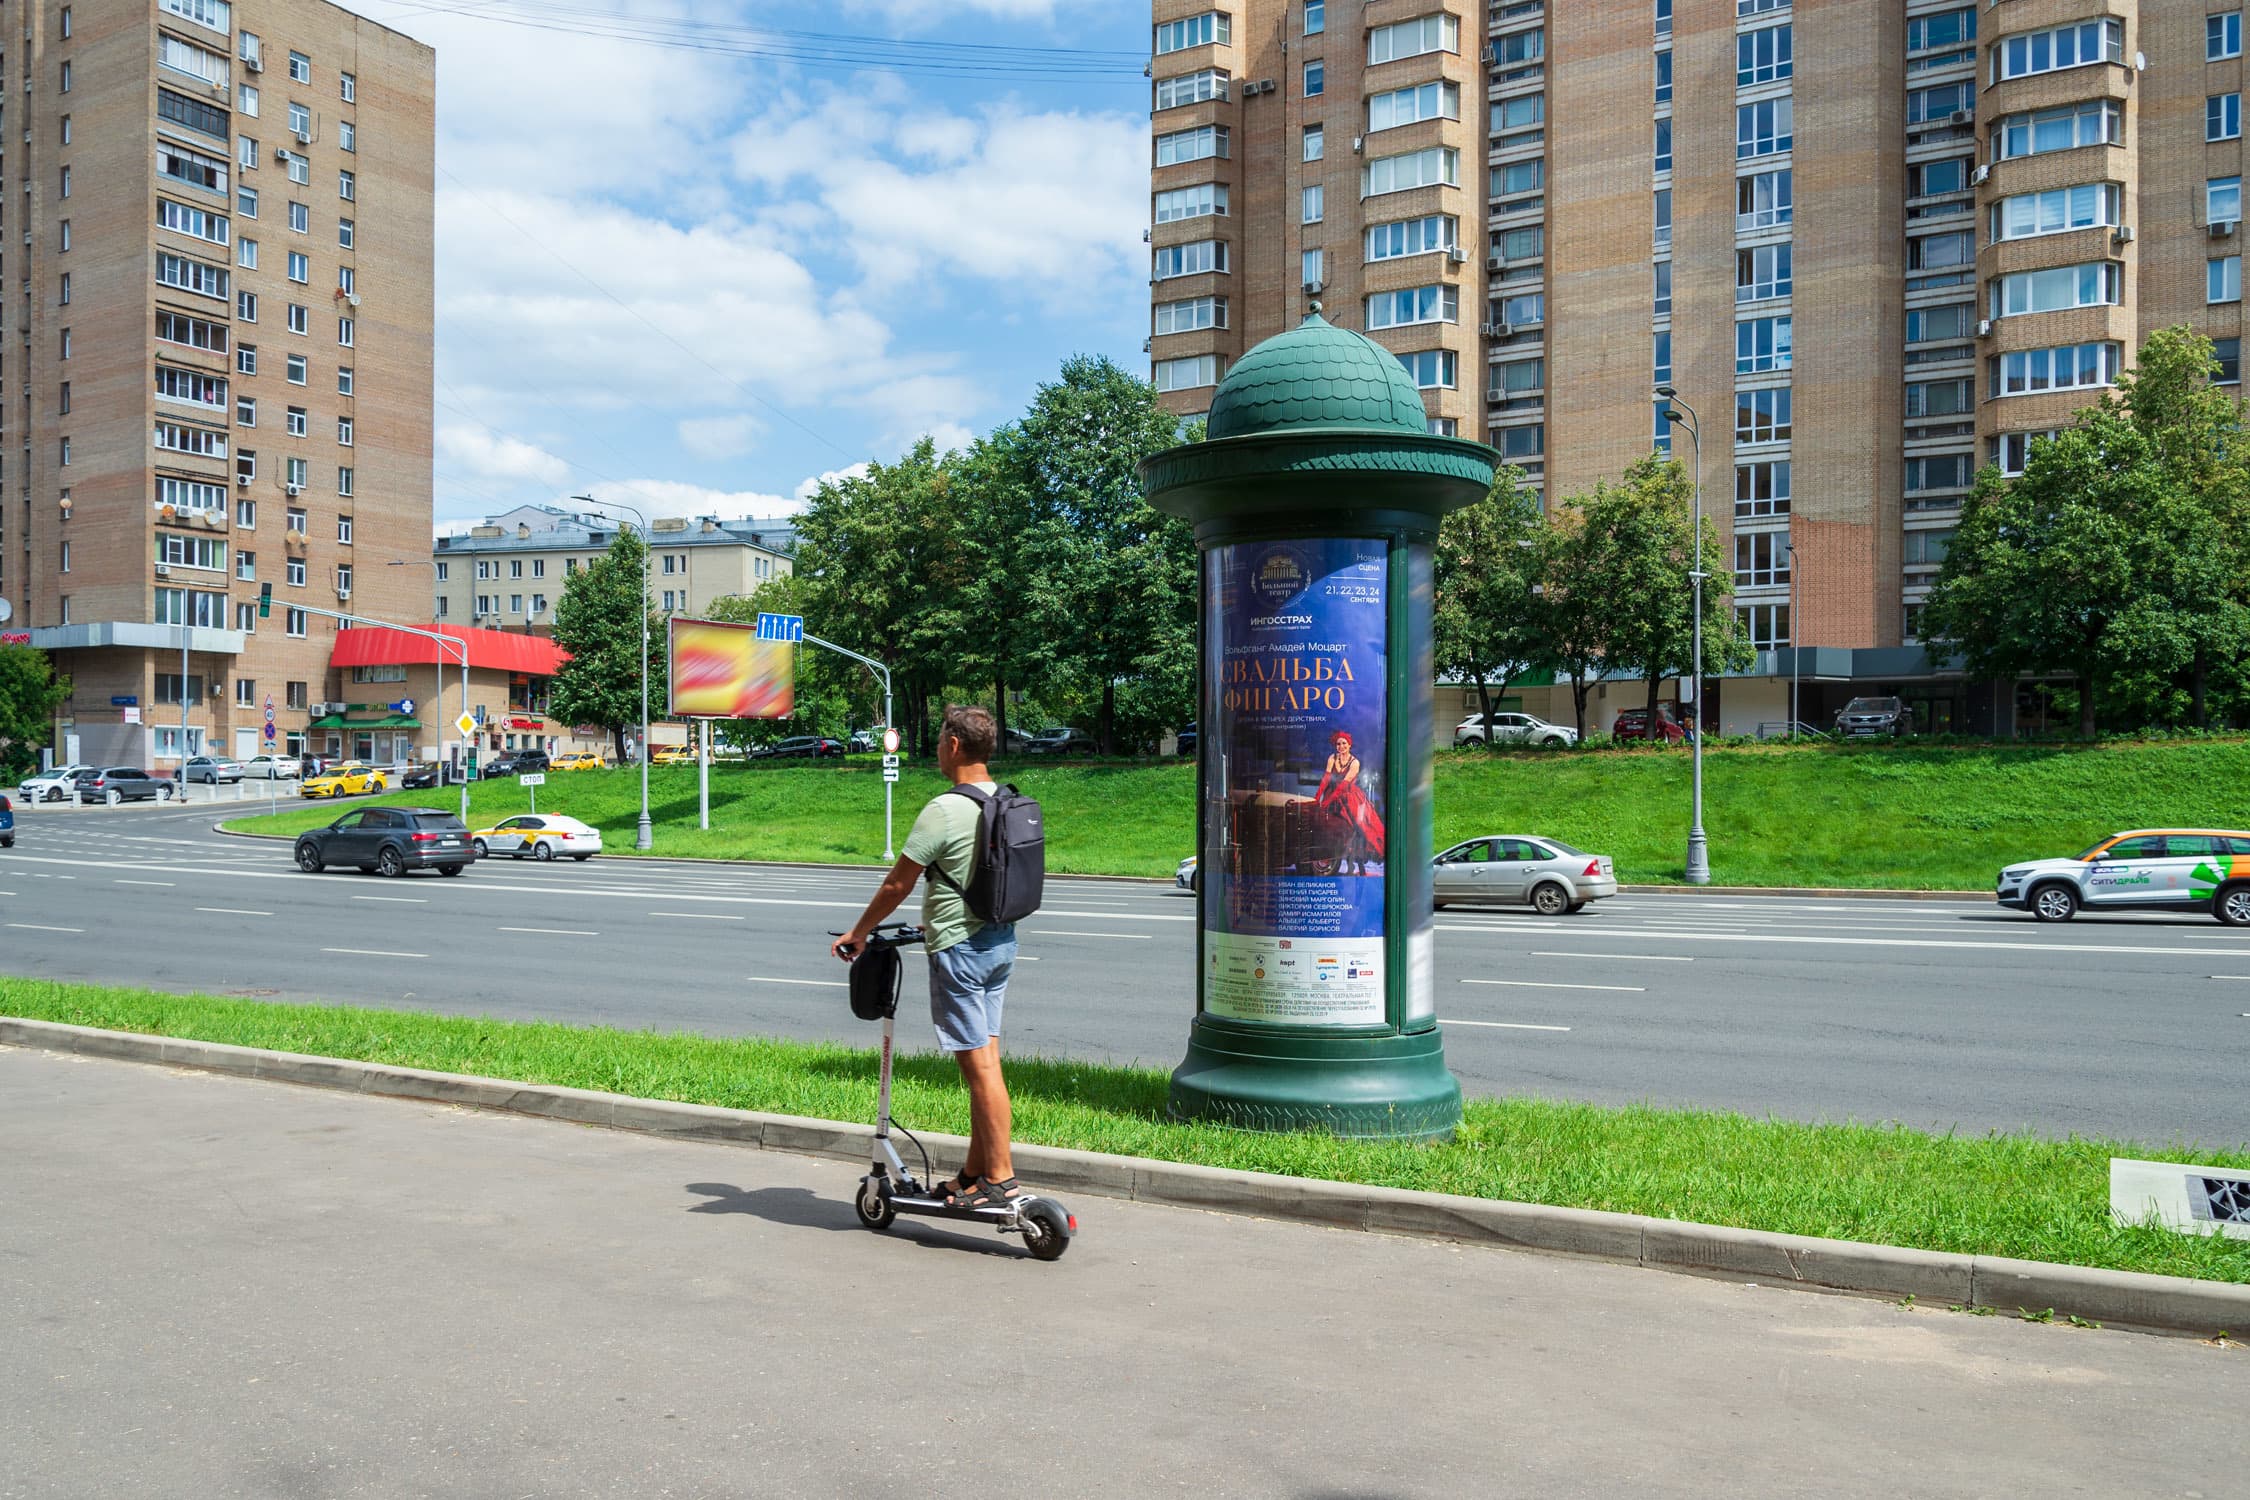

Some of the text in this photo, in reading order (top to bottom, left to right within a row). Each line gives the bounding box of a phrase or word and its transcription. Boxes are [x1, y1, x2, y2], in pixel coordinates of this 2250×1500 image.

[1370, 588, 1380, 596] 24
[1250, 615, 1313, 626] ИНГОССТРАХ
[1268, 643, 1305, 652] Амадей
[1308, 642, 1348, 654] Моцарт
[1221, 657, 1354, 685] СВАДЬБА
[1224, 686, 1345, 711] ФИГАРО
[523, 776, 542, 784] СТОП
[2091, 877, 2150, 886] СИТИДРАЙВ
